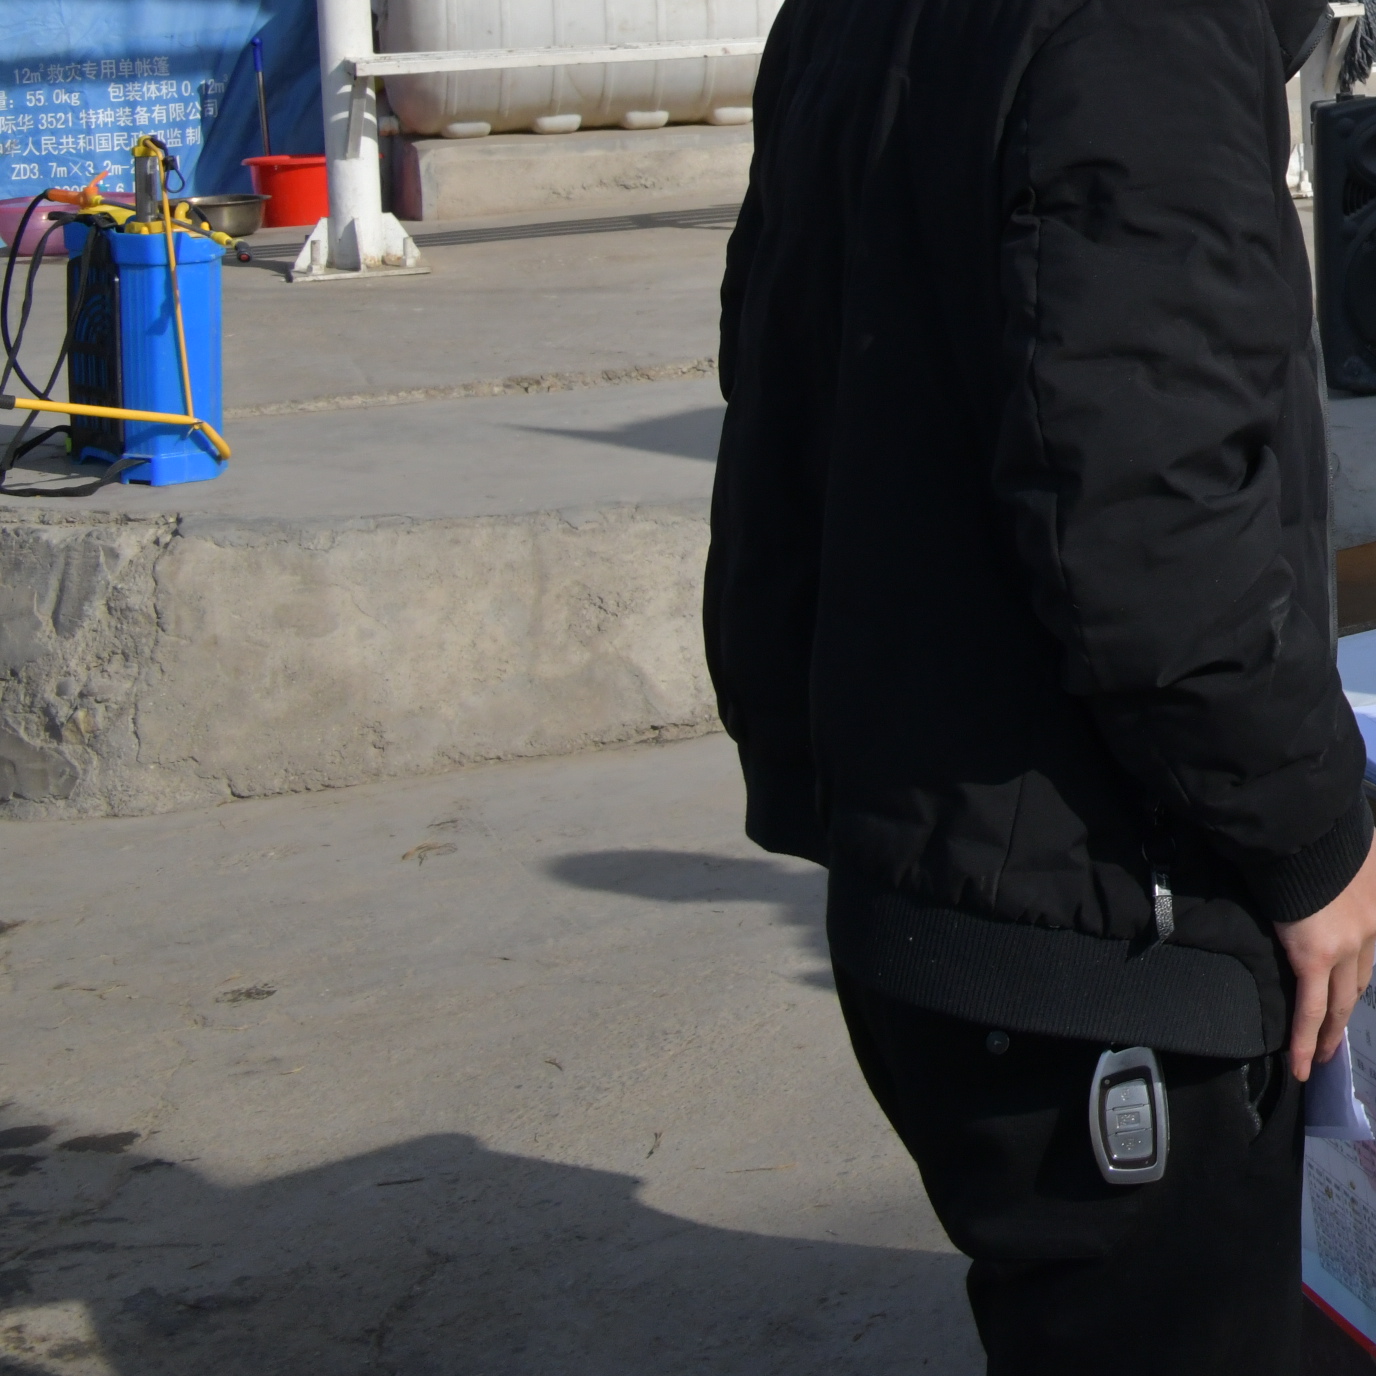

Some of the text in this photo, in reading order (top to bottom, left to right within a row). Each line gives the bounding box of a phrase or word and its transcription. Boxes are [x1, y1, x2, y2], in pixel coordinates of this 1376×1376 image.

[0, 126, 201, 157] 华人民共和国民监制
